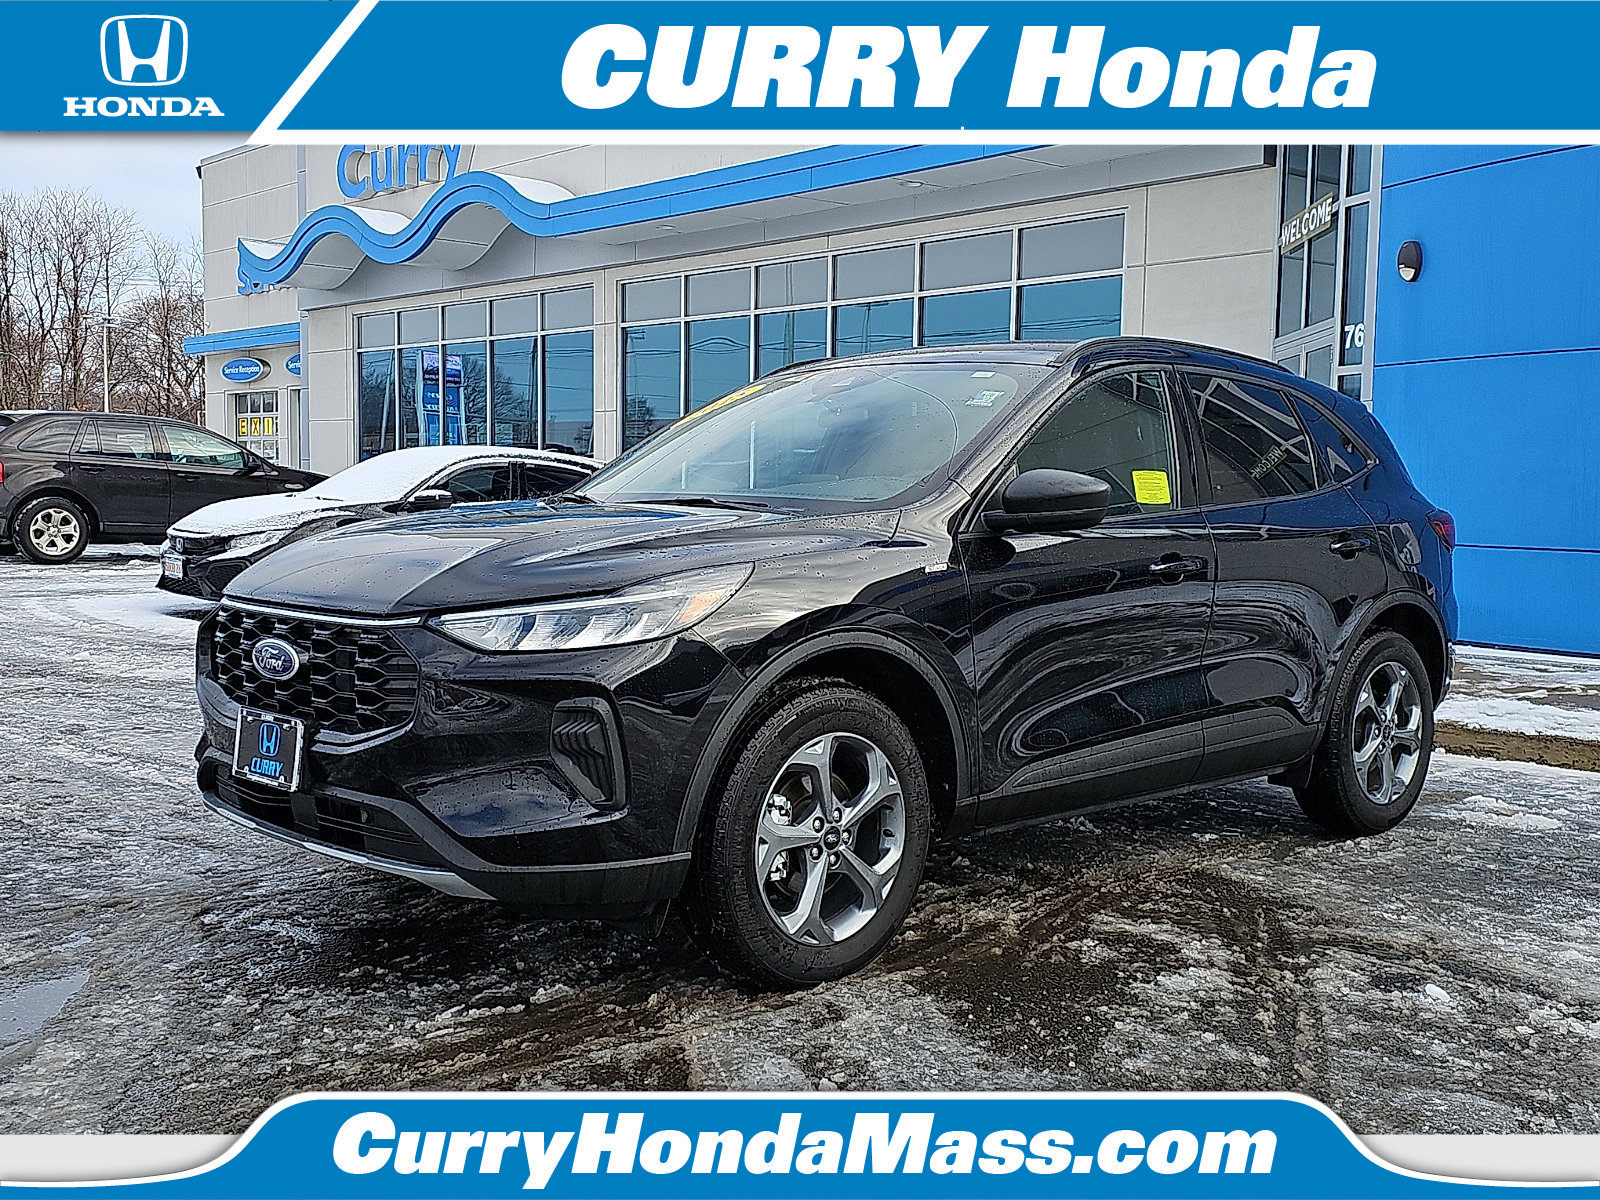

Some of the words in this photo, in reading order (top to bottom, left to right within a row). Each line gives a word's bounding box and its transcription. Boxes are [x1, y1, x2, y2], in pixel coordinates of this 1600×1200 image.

[336, 144, 463, 199] Curry
[1281, 196, 1333, 248] WELCOME
[1344, 323, 1365, 349] 76
[223, 365, 238, 374] Service
[259, 646, 286, 671] Ford
[250, 757, 284, 777] CURRY
